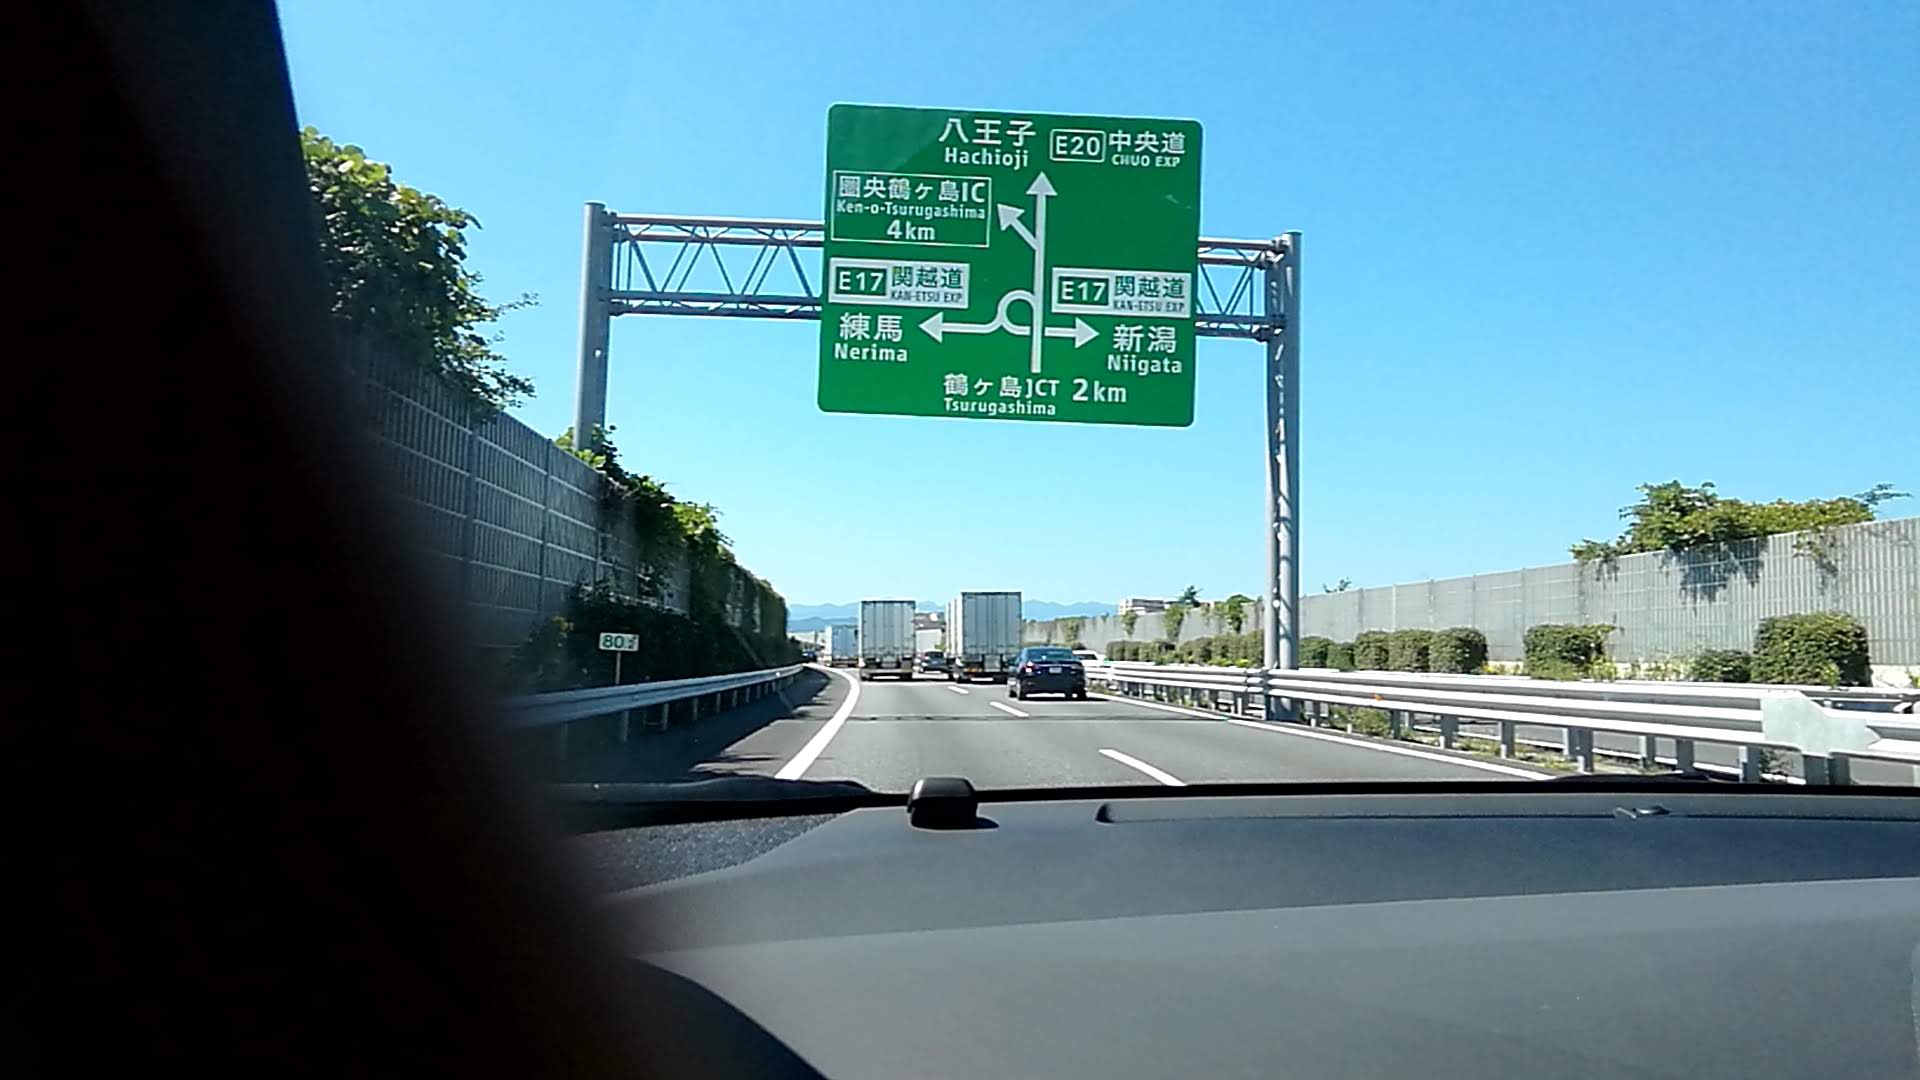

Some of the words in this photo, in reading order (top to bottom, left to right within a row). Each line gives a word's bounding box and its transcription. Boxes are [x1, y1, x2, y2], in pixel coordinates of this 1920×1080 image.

[938, 118, 1037, 148] 八王子
[1108, 129, 1186, 155] 中央道
[1055, 135, 1101, 157] E20
[944, 147, 1029, 171] Hachioji
[1111, 154, 1150, 167] CHUO
[1155, 155, 1181, 168] EXP
[836, 199, 986, 220] Ken-o-Tsurugashima
[838, 271, 884, 292] E17
[891, 265, 964, 290] 関越道
[1114, 275, 1186, 299] 関越道
[890, 290, 940, 303] KAN-ETSU
[943, 292, 963, 304] EXP
[1061, 280, 1107, 302] E17
[1112, 300, 1163, 313] KAN-ETSU
[1165, 302, 1186, 314] EXP
[839, 311, 903, 343] 練馬
[1112, 323, 1177, 354] 新潟
[834, 342, 908, 363] Nerima
[1107, 353, 1183, 376] Niigata
[944, 397, 1056, 416] Tsurugashima
